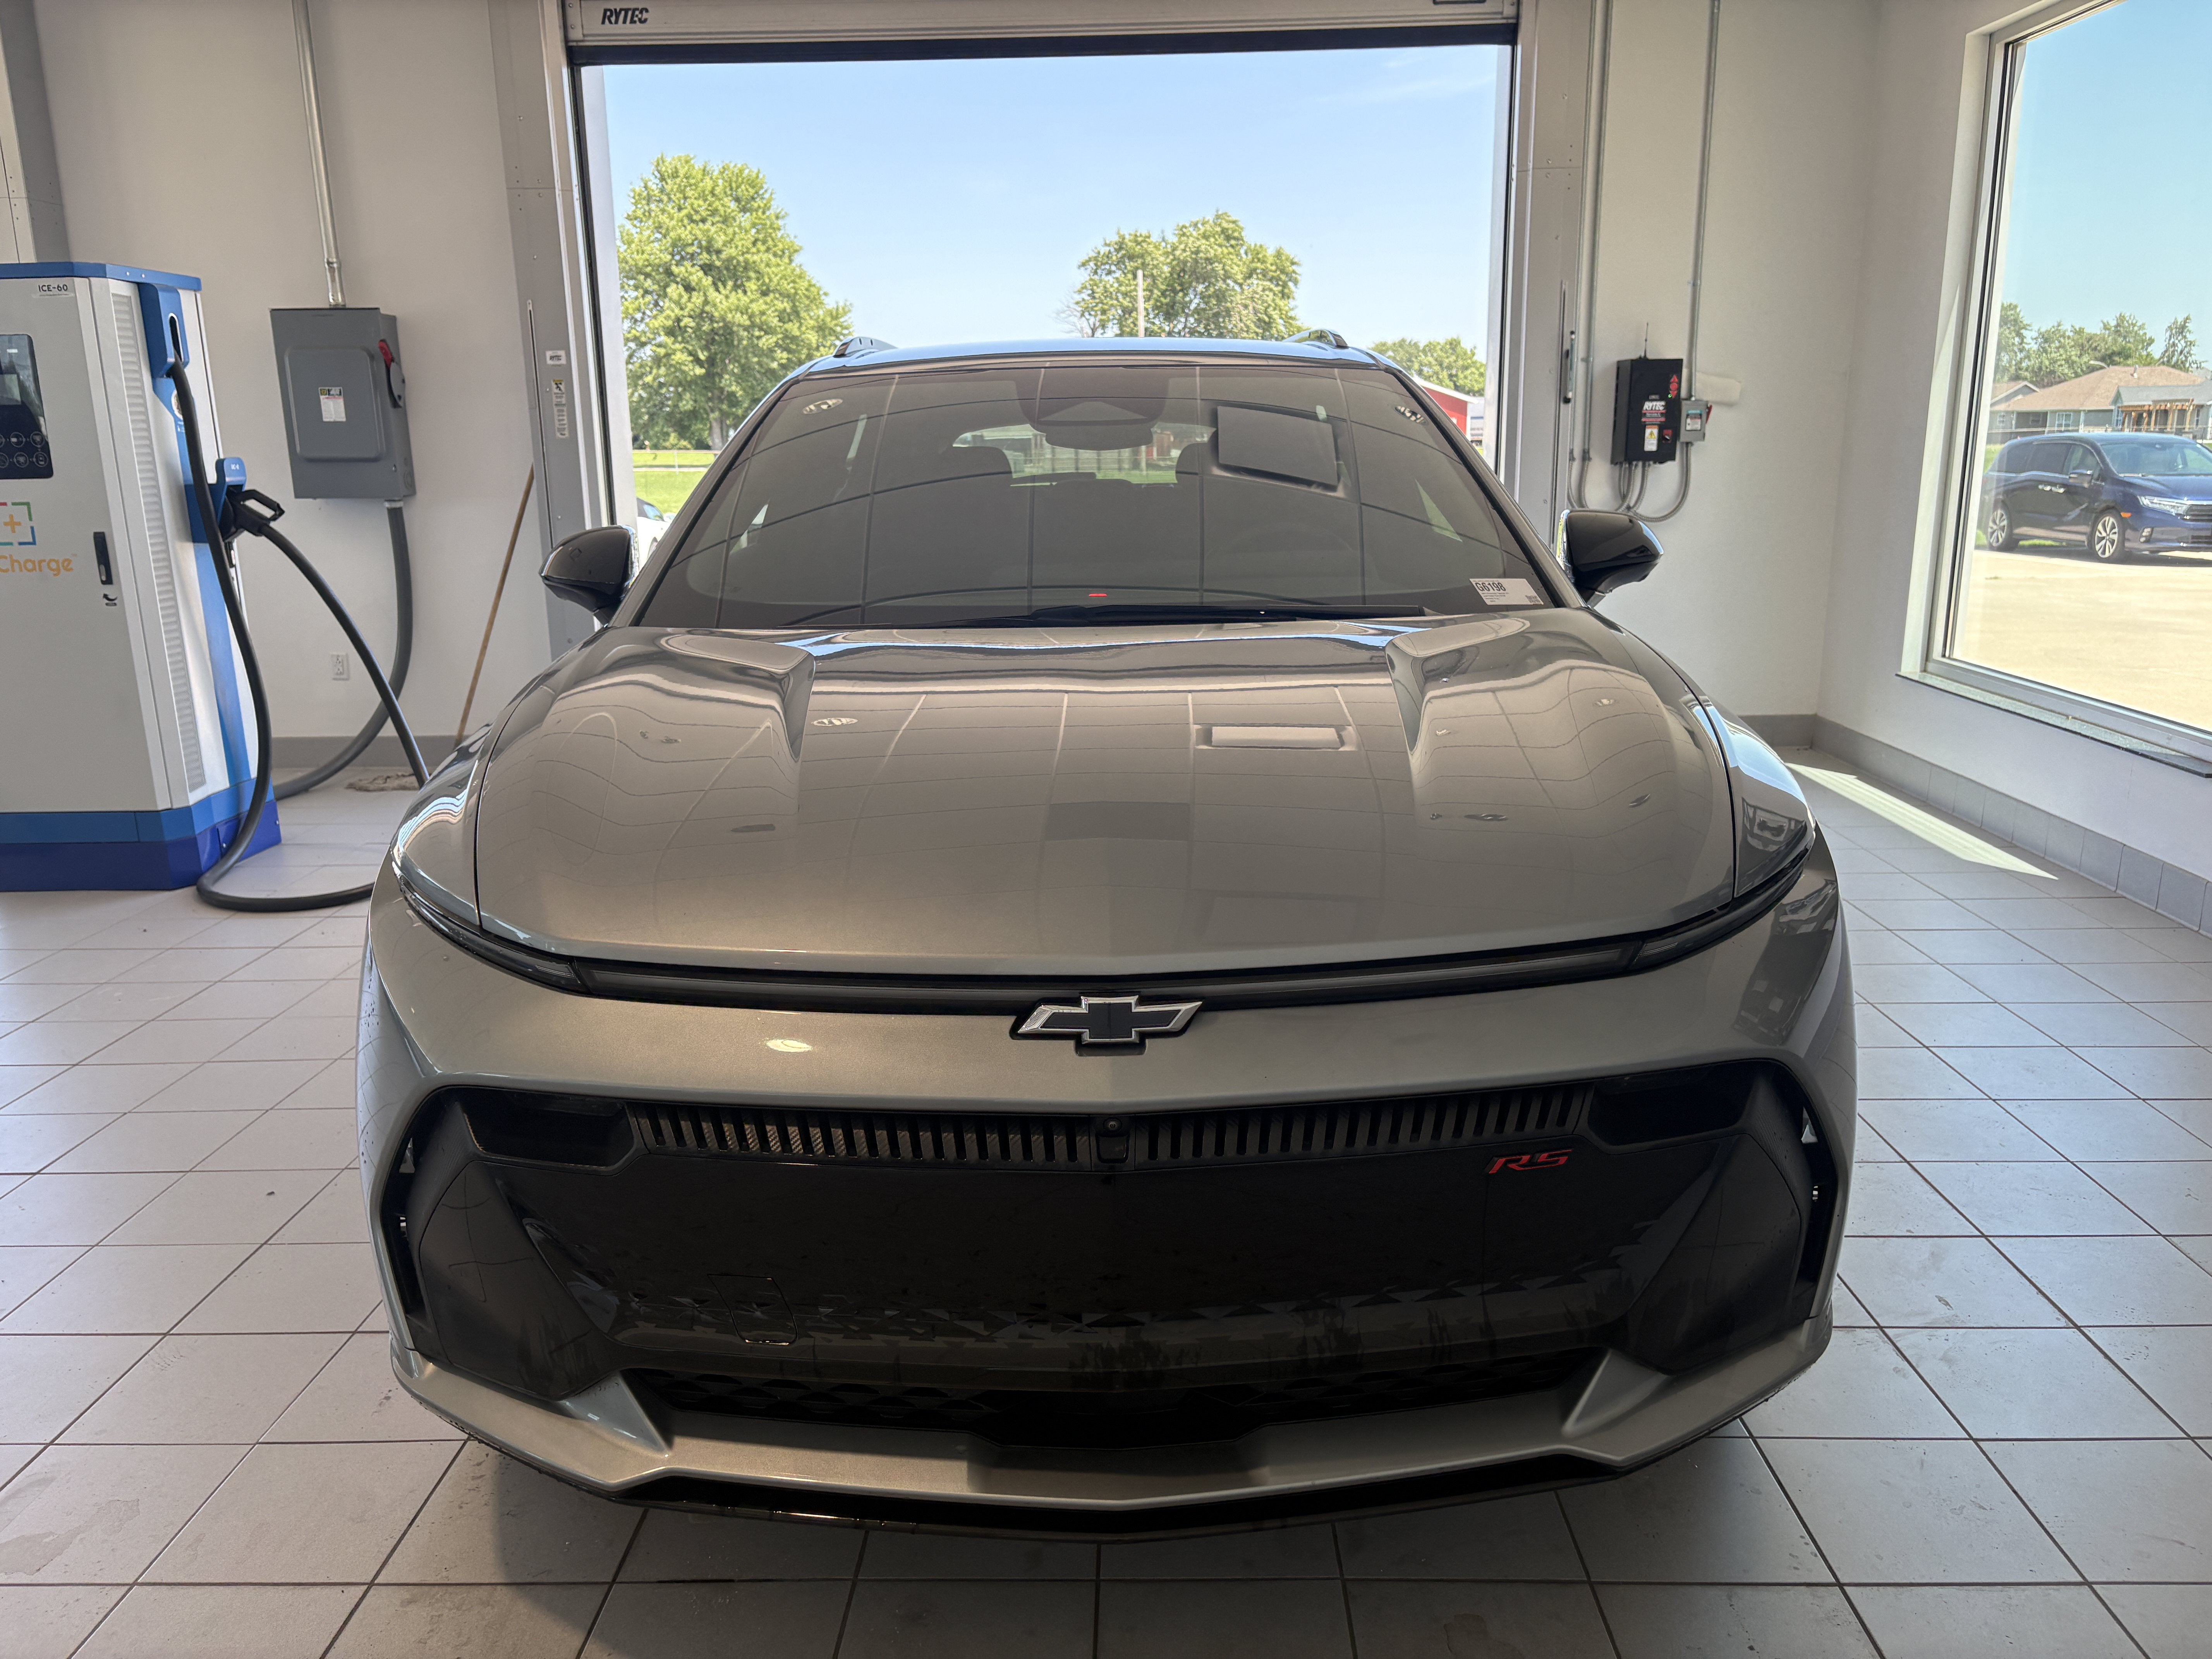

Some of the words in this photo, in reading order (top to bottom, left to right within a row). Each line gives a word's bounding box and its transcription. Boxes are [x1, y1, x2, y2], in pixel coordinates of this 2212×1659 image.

[601, 7, 650, 25] RYTEC
[38, 284, 68, 292] ICE-60
[1475, 582, 1506, 592] G6198
[1486, 1149, 1574, 1174] RS
